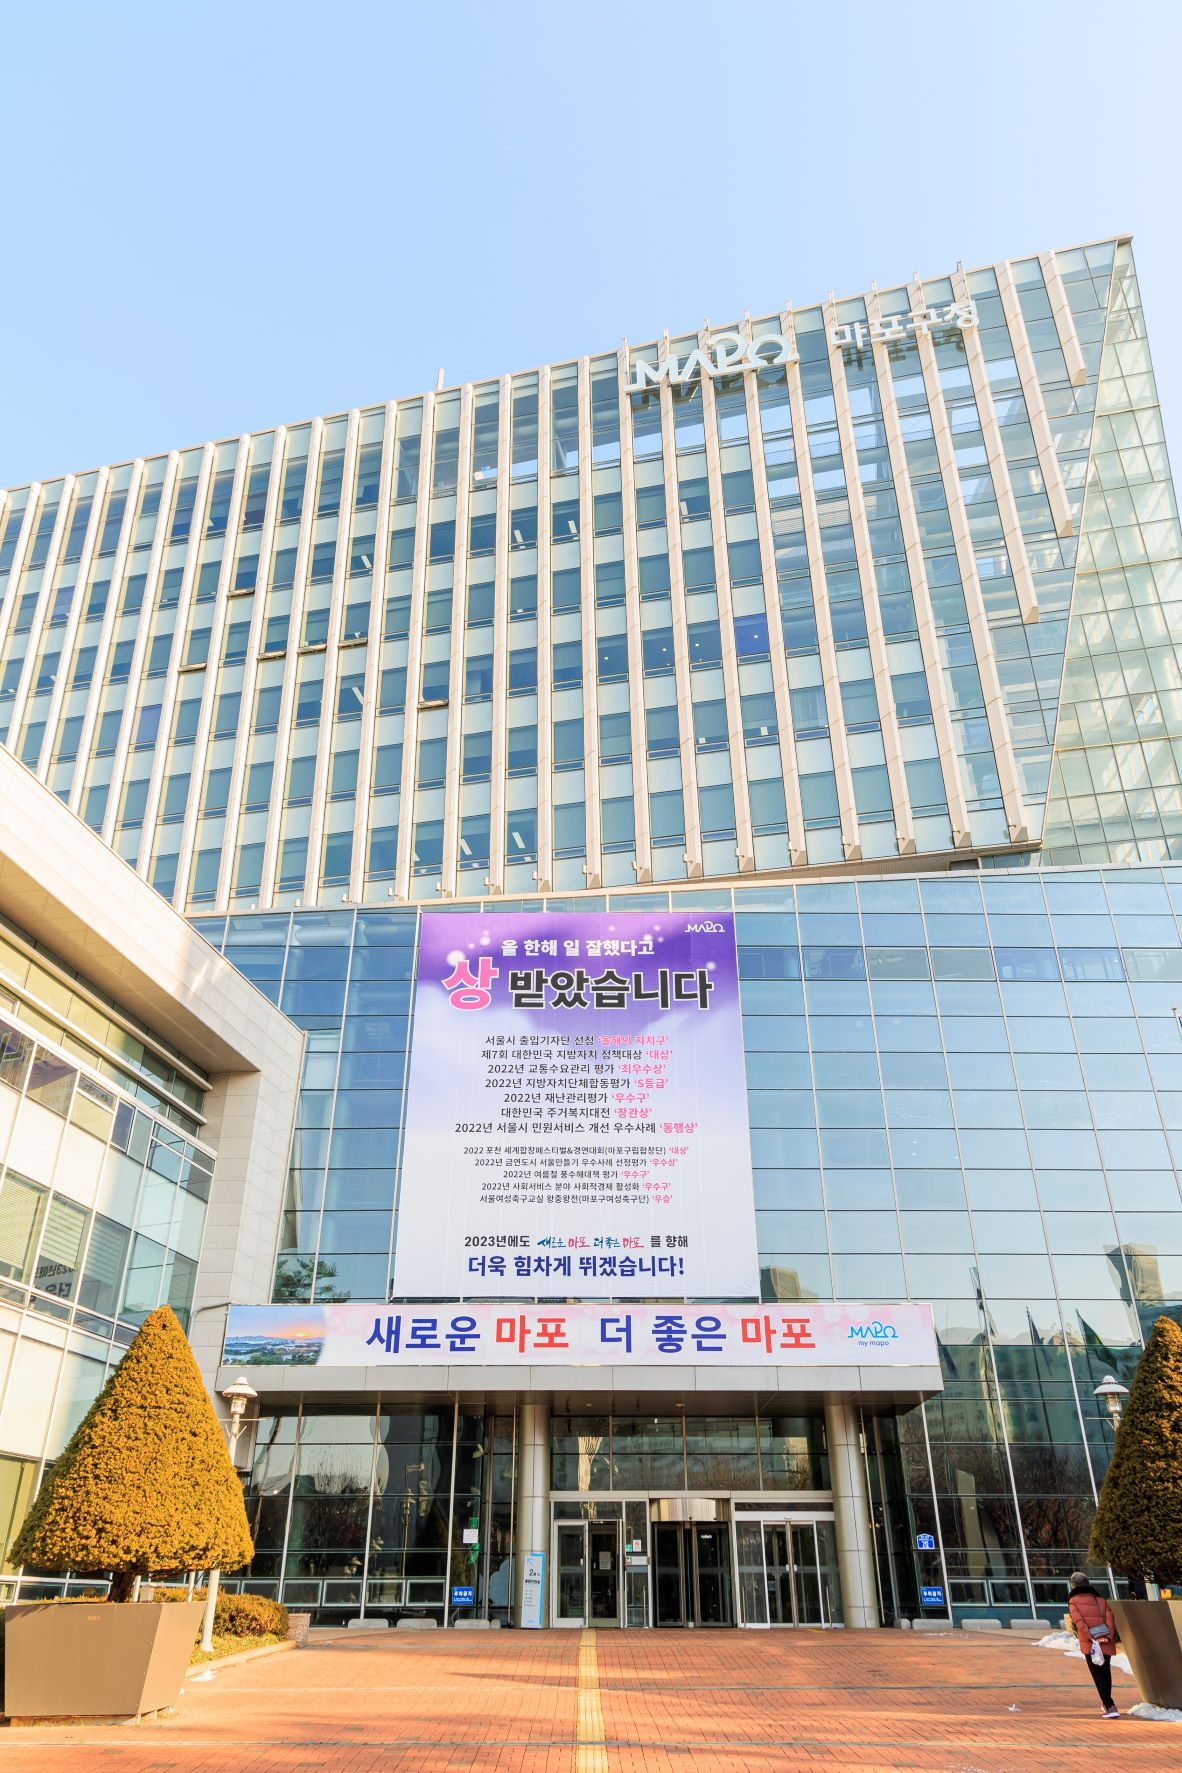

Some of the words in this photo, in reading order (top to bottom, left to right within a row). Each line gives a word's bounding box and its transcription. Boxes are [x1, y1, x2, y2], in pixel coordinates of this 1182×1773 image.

[830, 300, 979, 348] 마포구청
[501, 939, 518, 956] 올
[524, 939, 557, 956] 한해
[564, 939, 579, 956] 일
[586, 939, 654, 956] 잘했다고
[442, 957, 499, 1010] 상
[509, 969, 713, 1010] 받았습니다
[485, 1036, 515, 1045] 서울시
[520, 1034, 569, 1045] 출입기자단
[575, 1036, 593, 1045] 선정
[481, 1050, 507, 1060] 제7회
[512, 1050, 552, 1059] 대한민국
[557, 1050, 596, 1059] 지방자치
[602, 1050, 642, 1060] 정책대상
[647, 1050, 672, 1059] ‘대상’
[488, 1064, 524, 1073] 2022년
[529, 1064, 589, 1074] 교통수요관리
[595, 1064, 614, 1074] 평가
[485, 1078, 521, 1088] 2022년
[526, 1078, 630, 1088] 지방자치단체합동평가
[504, 1093, 540, 1103] 2022년
[545, 1093, 608, 1103] 재난관리평가
[501, 1108, 543, 1118] 대한민국
[547, 1108, 609, 1118] 주거복지대전
[455, 1123, 492, 1133] 2022년
[497, 1122, 527, 1133] 서울시
[533, 1123, 584, 1133] 민원서비스
[589, 1123, 609, 1133] 개선
[614, 1123, 655, 1133] 우수사례
[486, 1147, 501, 1155] 포천
[475, 1158, 502, 1166] 2022년
[603, 1171, 618, 1179] 평가
[513, 1183, 552, 1191] 사회서비스
[555, 1183, 570, 1191] 분야
[574, 1183, 612, 1191] 사회적경제
[616, 1183, 639, 1191] 활성화
[480, 1195, 544, 1203] 서울여성축구교실
[465, 1235, 530, 1247] 2023년에도
[568, 1237, 590, 1249] 마포
[622, 1237, 644, 1249] 마포
[651, 1236, 661, 1247] 를
[666, 1235, 688, 1248] 향해
[469, 1256, 506, 1276] 더욱
[514, 1256, 571, 1276] 힘차게
[579, 1256, 684, 1277] 뛰겠습니다!
[366, 1315, 481, 1353] 새로운
[495, 1315, 569, 1353] 마포
[600, 1315, 632, 1353] 더
[652, 1315, 727, 1353] 좋은
[741, 1315, 816, 1353] 마포
